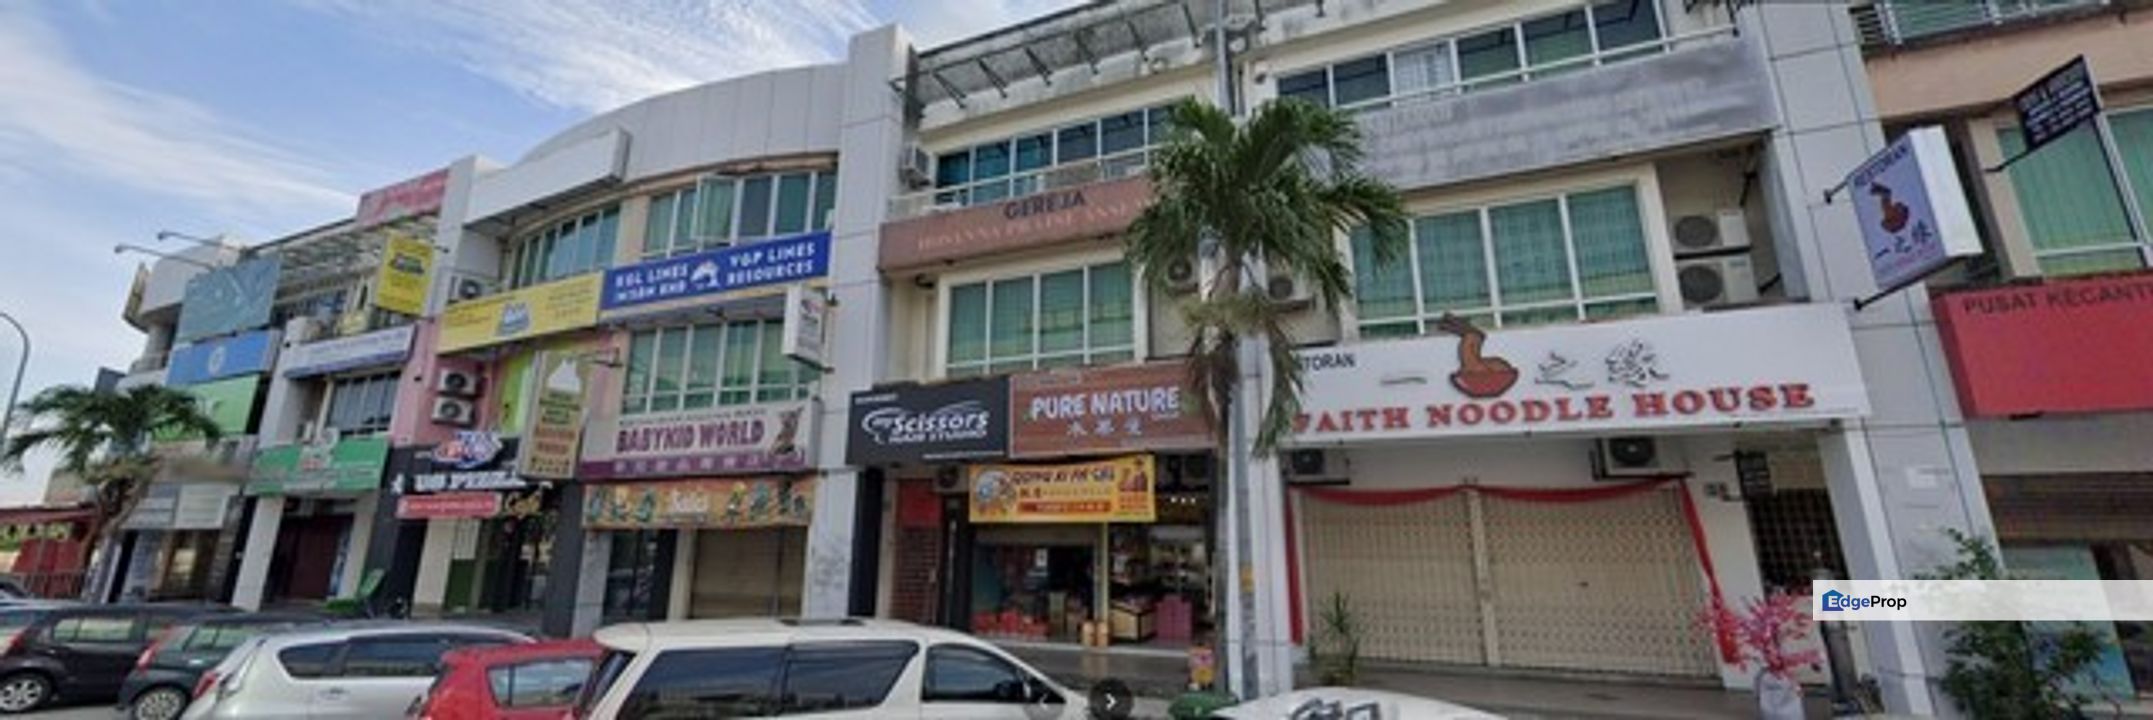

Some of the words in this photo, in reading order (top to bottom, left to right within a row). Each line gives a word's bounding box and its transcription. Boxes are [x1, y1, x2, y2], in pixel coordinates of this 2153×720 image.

[1004, 191, 1085, 219] GEREJA
[767, 242, 815, 263] LINES
[647, 262, 688, 284] LINES
[726, 259, 814, 285] RESOURCES
[1963, 292, 2037, 314] PUSAT
[2047, 283, 2153, 308] KECANT
[1031, 393, 1087, 421] PURE
[1090, 386, 1180, 415] NATURE
[1292, 407, 1410, 433] FAITH
[1426, 395, 1614, 427] NOODLE
[1631, 383, 1815, 417] HOUSE
[893, 411, 990, 433] Scissors
[616, 424, 695, 454] BABYKID
[700, 420, 766, 448] WORLD
